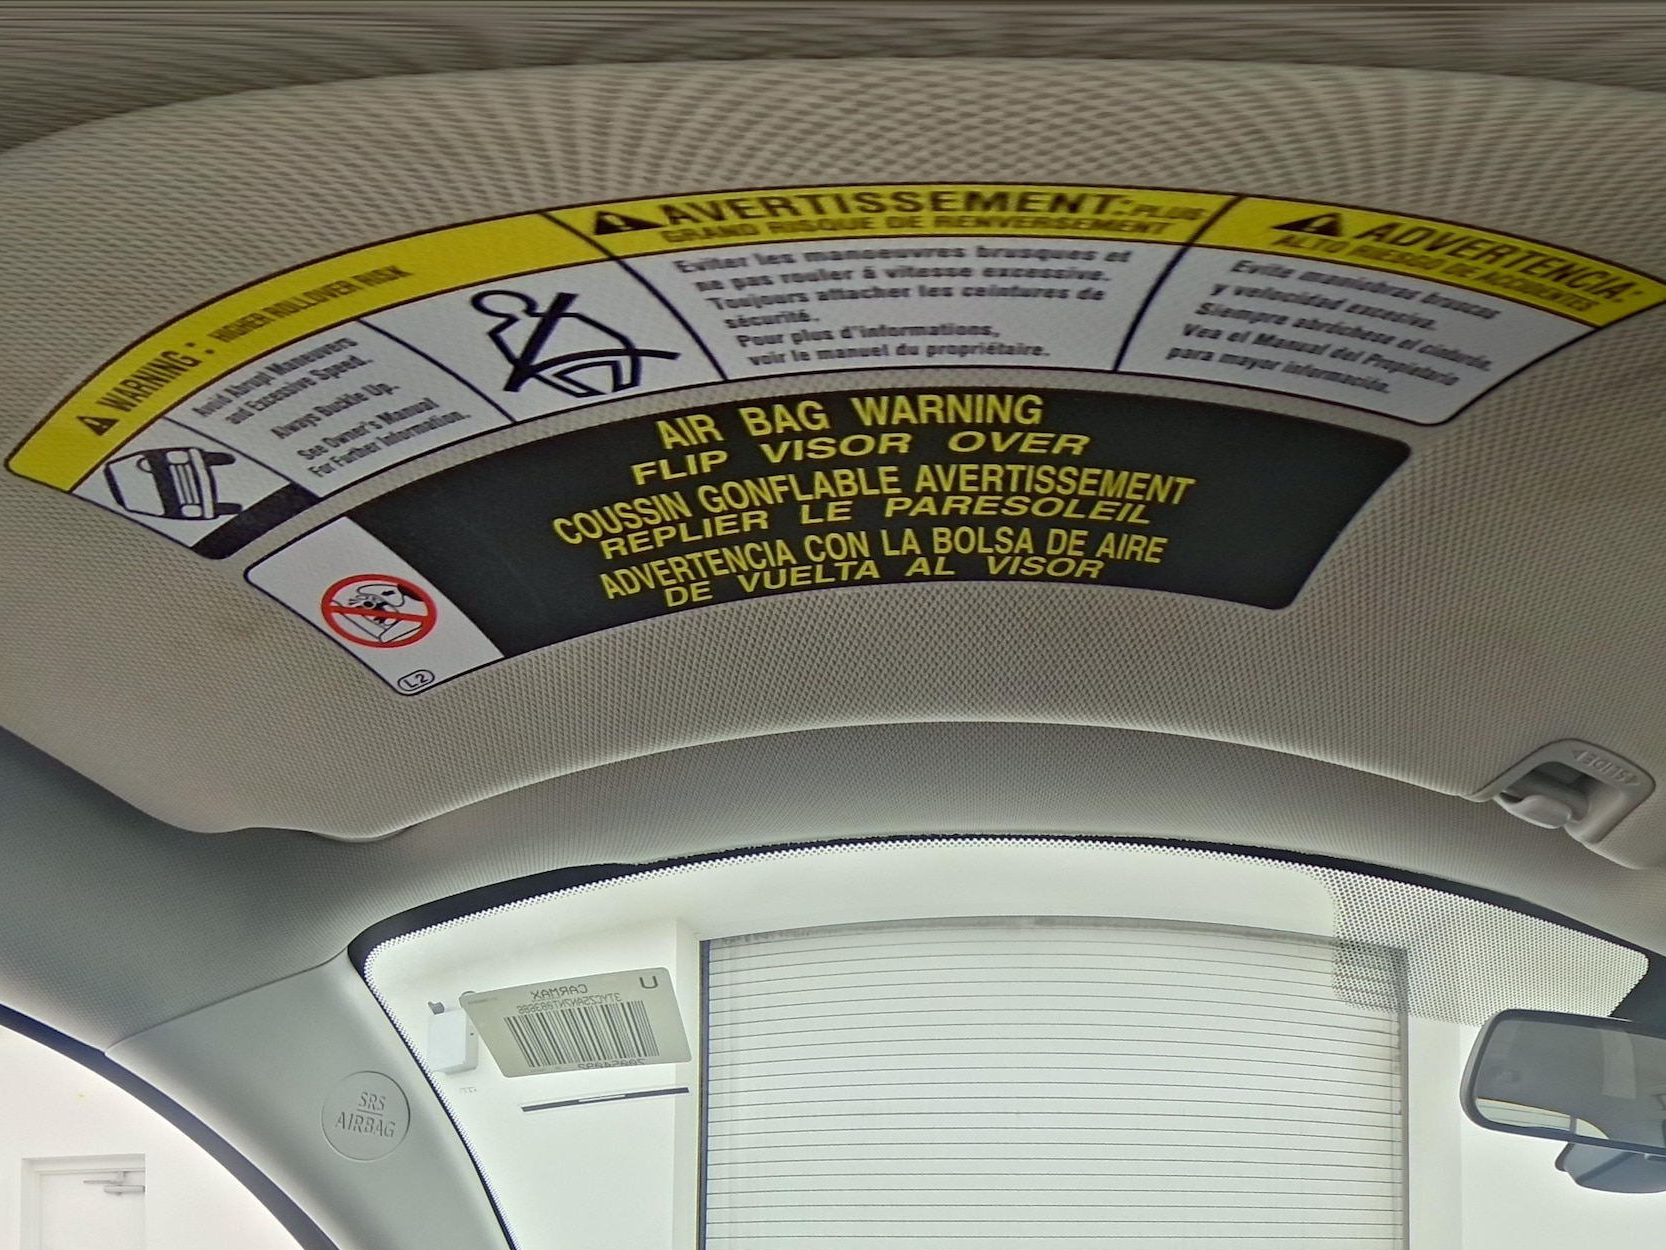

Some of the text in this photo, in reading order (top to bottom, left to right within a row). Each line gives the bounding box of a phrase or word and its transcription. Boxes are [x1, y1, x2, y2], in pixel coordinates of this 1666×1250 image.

[660, 215, 1175, 242] GRAND RISQUE DE RENVERSEMENT
[752, 252, 796, 266] les
[976, 246, 1099, 262] brusques
[1104, 250, 1133, 263] et
[1271, 234, 1349, 253] ALTO
[1346, 245, 1445, 270] RIESGO
[1440, 262, 1483, 279] DE
[694, 280, 724, 292] ne
[730, 274, 774, 291] pas
[781, 268, 855, 284] rouler
[884, 266, 973, 279] vitesse
[983, 267, 1112, 282] excessive.
[705, 284, 1106, 311] Toujours attacher les ceintures de
[1233, 284, 1347, 310] velocidad
[207, 264, 414, 343] HIGHER ROLLOVER RISK
[1195, 302, 1289, 326] Siempre
[736, 332, 784, 348] Pour
[789, 327, 835, 345] plus
[747, 351, 786, 366] voir
[791, 349, 811, 362] le
[816, 344, 890, 360] manuel
[895, 342, 920, 356] du
[1183, 323, 1222, 339] Vea
[1226, 330, 1252, 343] el
[1252, 333, 1331, 355] Manual
[1328, 347, 1366, 363] del
[191, 337, 358, 418] Avoid Abrupt Maneuvers
[1166, 347, 1215, 361] para
[1218, 352, 1281, 371] mayor
[224, 355, 373, 425] and Excessive Speed.
[269, 411, 321, 440] Always
[313, 389, 369, 417] Buckle
[296, 397, 441, 461] See Owner's Manual
[656, 394, 1044, 450] AIR BAG WARNING
[308, 409, 472, 478] For Further Information.
[630, 430, 1092, 486] FLIP VISOR OVER
[552, 463, 1197, 546] COUSSIN GONFLABLE AVERTISSEMENT
[599, 495, 1152, 560] REPLIER LE PARESOLEIL
[599, 526, 1169, 600] ADVERTENCIA CON LA BOLSA DE AIRE
[664, 556, 1105, 608] DE VUELTA AL VISOR
[403, 673, 429, 688] L2
[358, 1091, 386, 1111] SRS
[335, 1111, 396, 1138] AIRBAG
